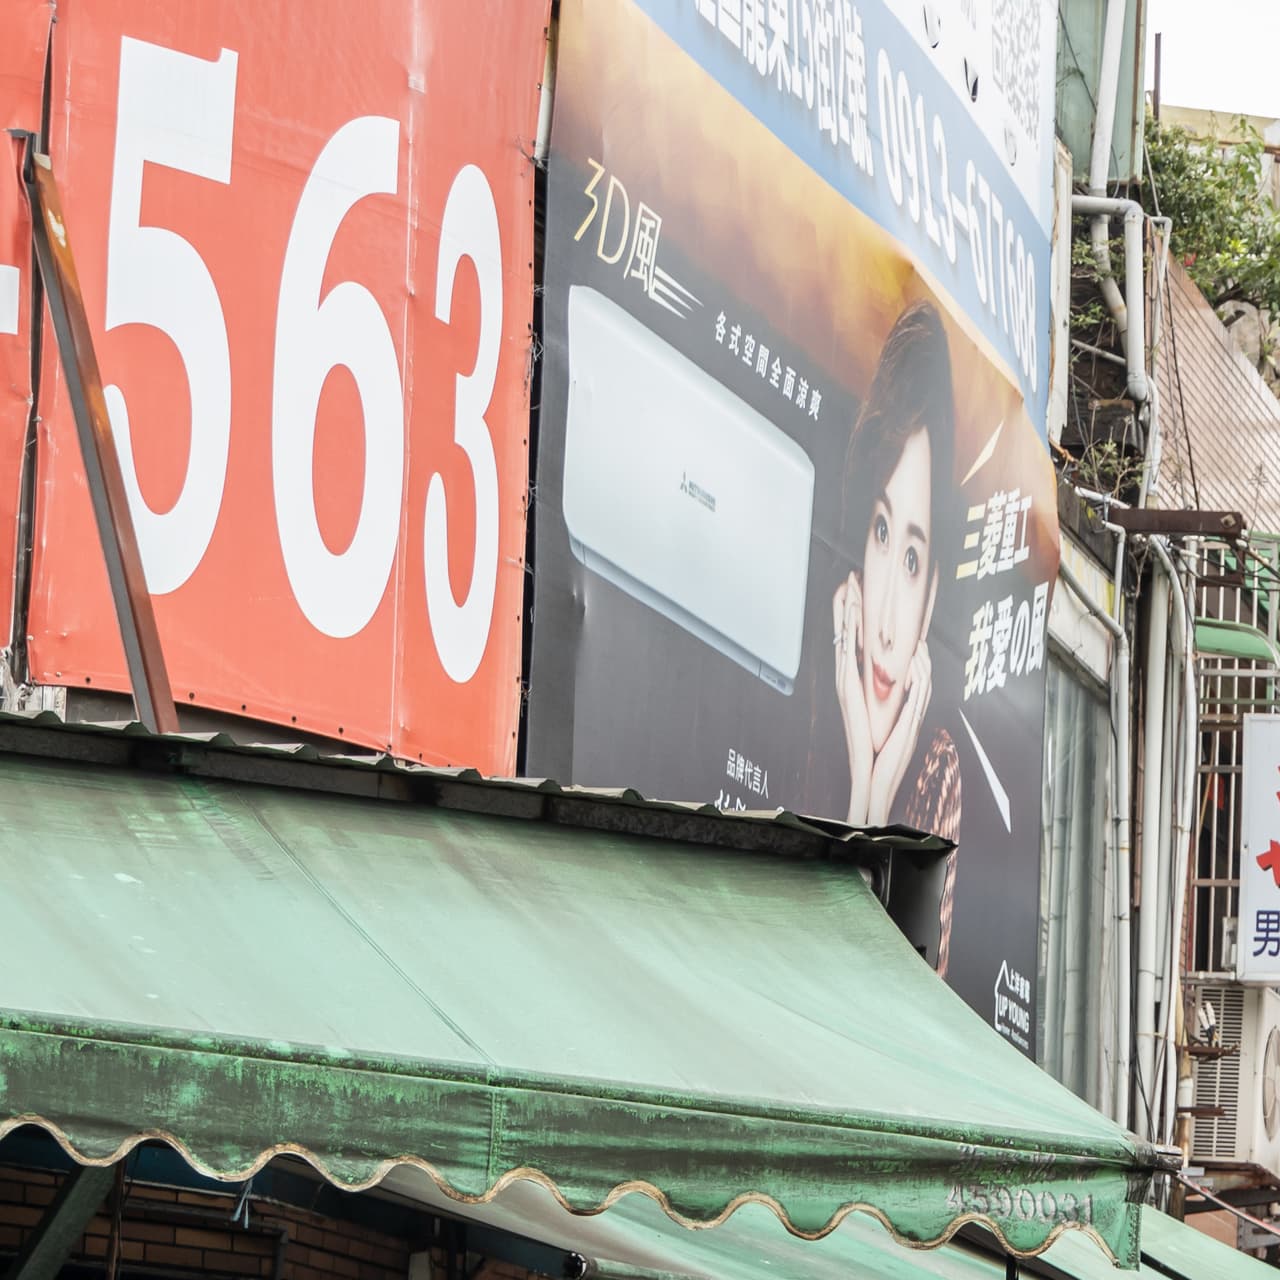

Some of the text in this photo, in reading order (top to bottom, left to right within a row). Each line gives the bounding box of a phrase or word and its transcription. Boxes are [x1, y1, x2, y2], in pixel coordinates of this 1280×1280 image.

[877, 48, 1038, 393] 0913-677688
[714, 311, 822, 421] 各式空間全面涼爽
[956, 488, 1033, 580] 三菱重工
[963, 581, 1049, 701] 我愛の風
[726, 747, 769, 800] 品牌代言人
[1008, 999, 1029, 1034] YOUNG
